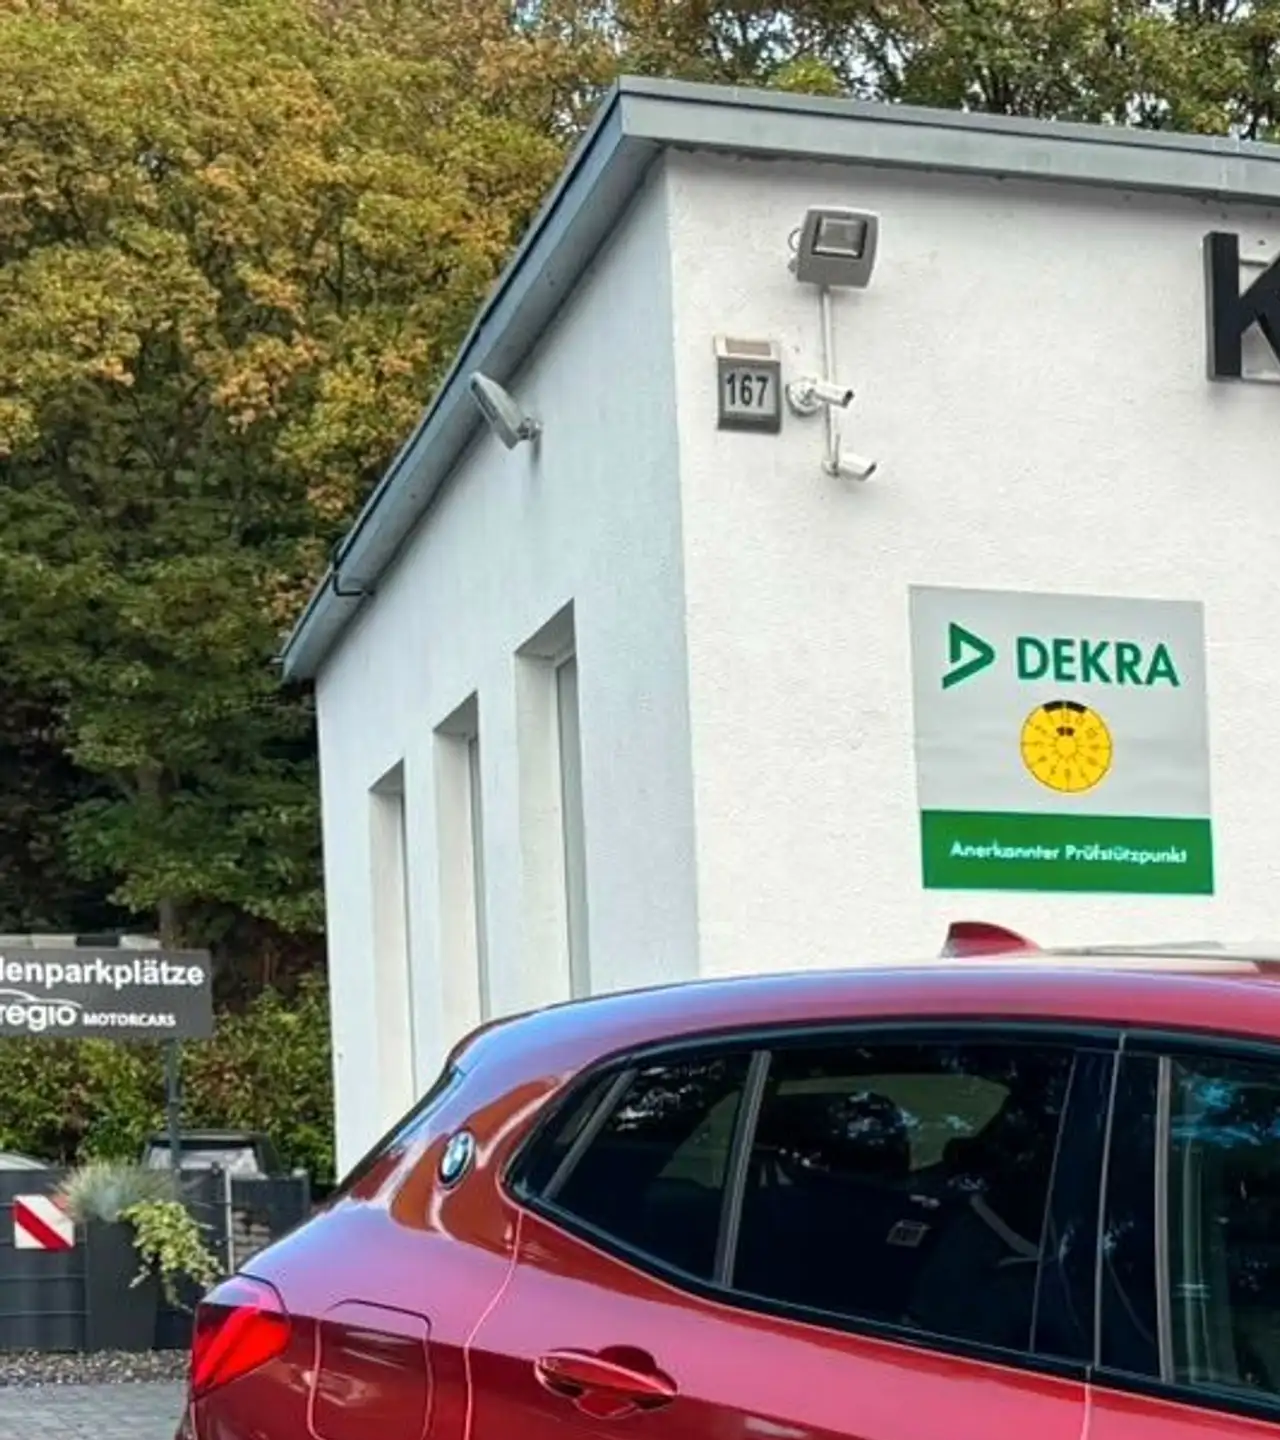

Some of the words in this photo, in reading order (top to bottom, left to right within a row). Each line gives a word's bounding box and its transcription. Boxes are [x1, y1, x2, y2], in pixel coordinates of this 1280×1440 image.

[726, 373, 770, 407] 167
[1016, 636, 1180, 687] DEKRA
[950, 841, 1059, 861] Anerkannter
[1066, 843, 1187, 865] Prüfstützpunkt
[0, 956, 206, 989] enparkplätze
[82, 1012, 177, 1027] MOTORCARS
